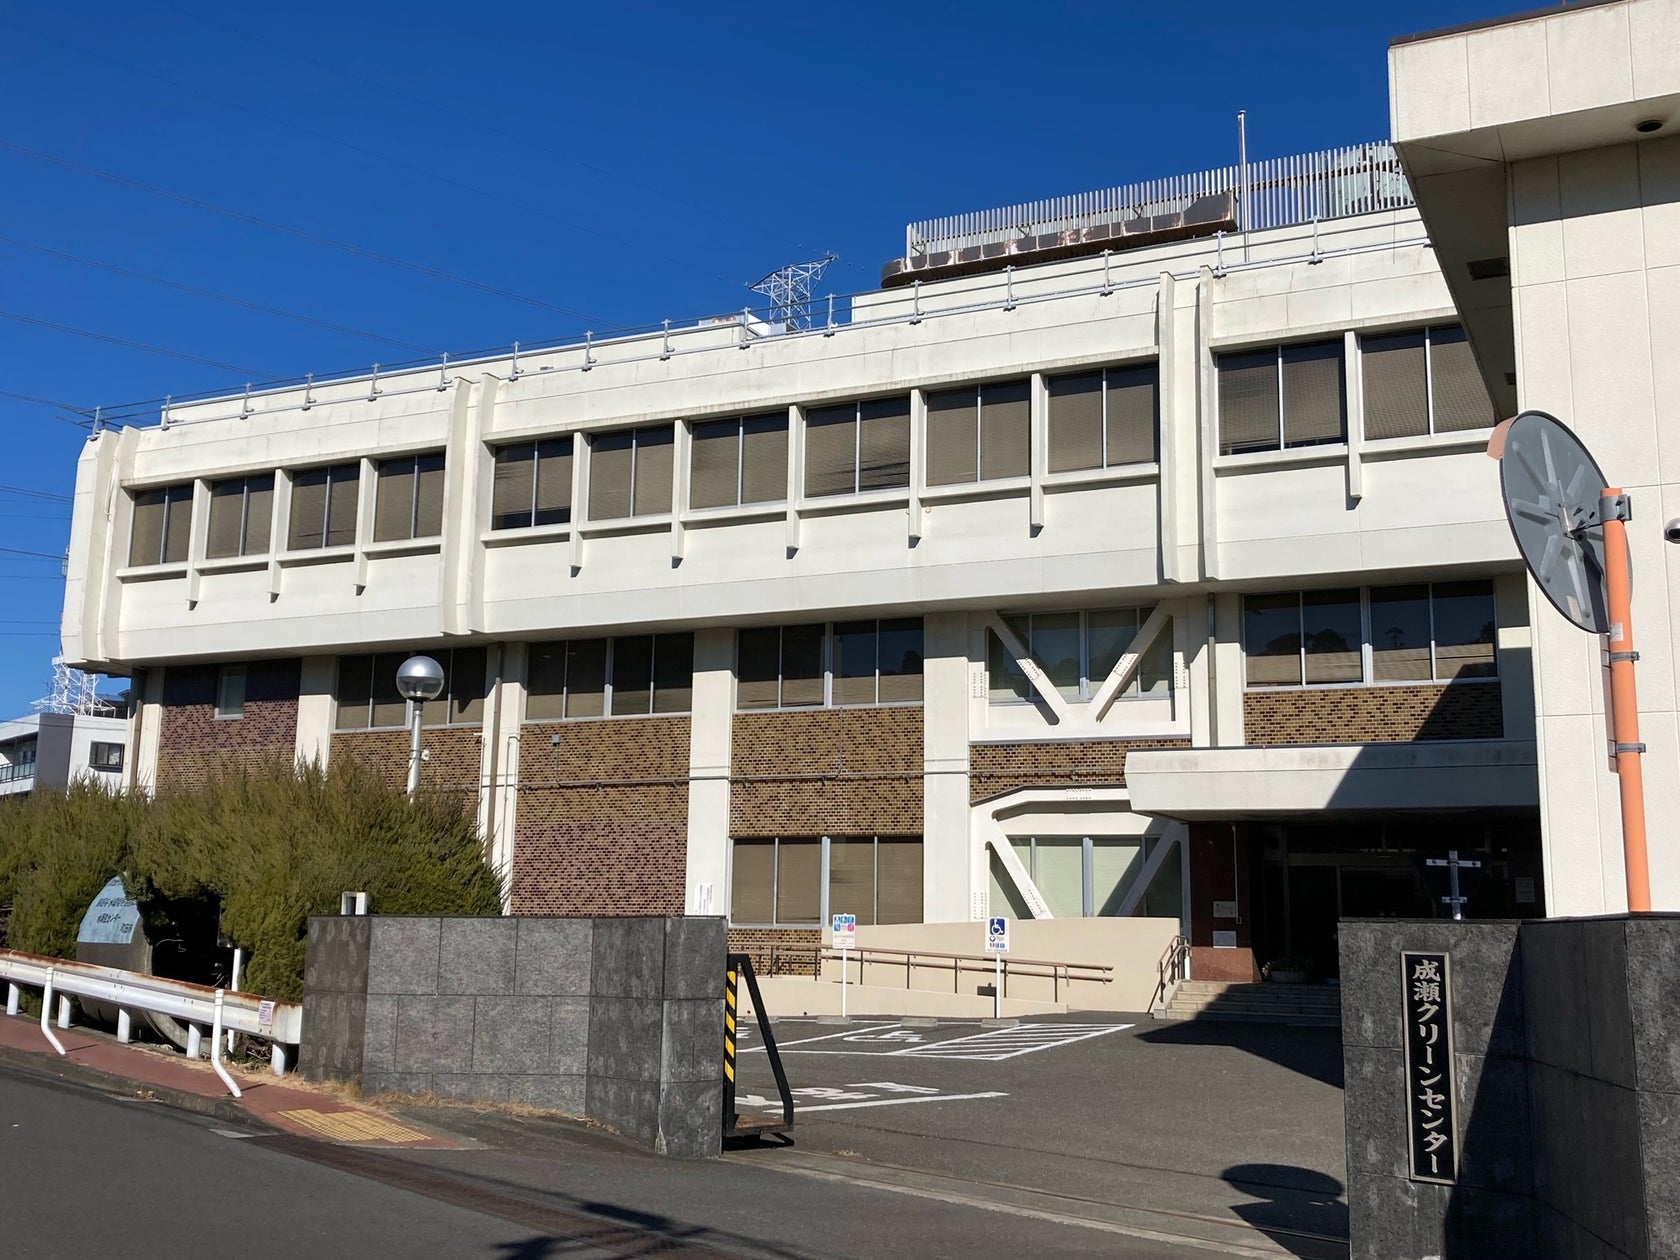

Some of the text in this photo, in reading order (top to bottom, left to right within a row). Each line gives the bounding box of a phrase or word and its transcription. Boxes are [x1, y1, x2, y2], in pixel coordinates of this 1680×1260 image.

[1412, 959, 1449, 1174] 成瀬クリーンセンター
